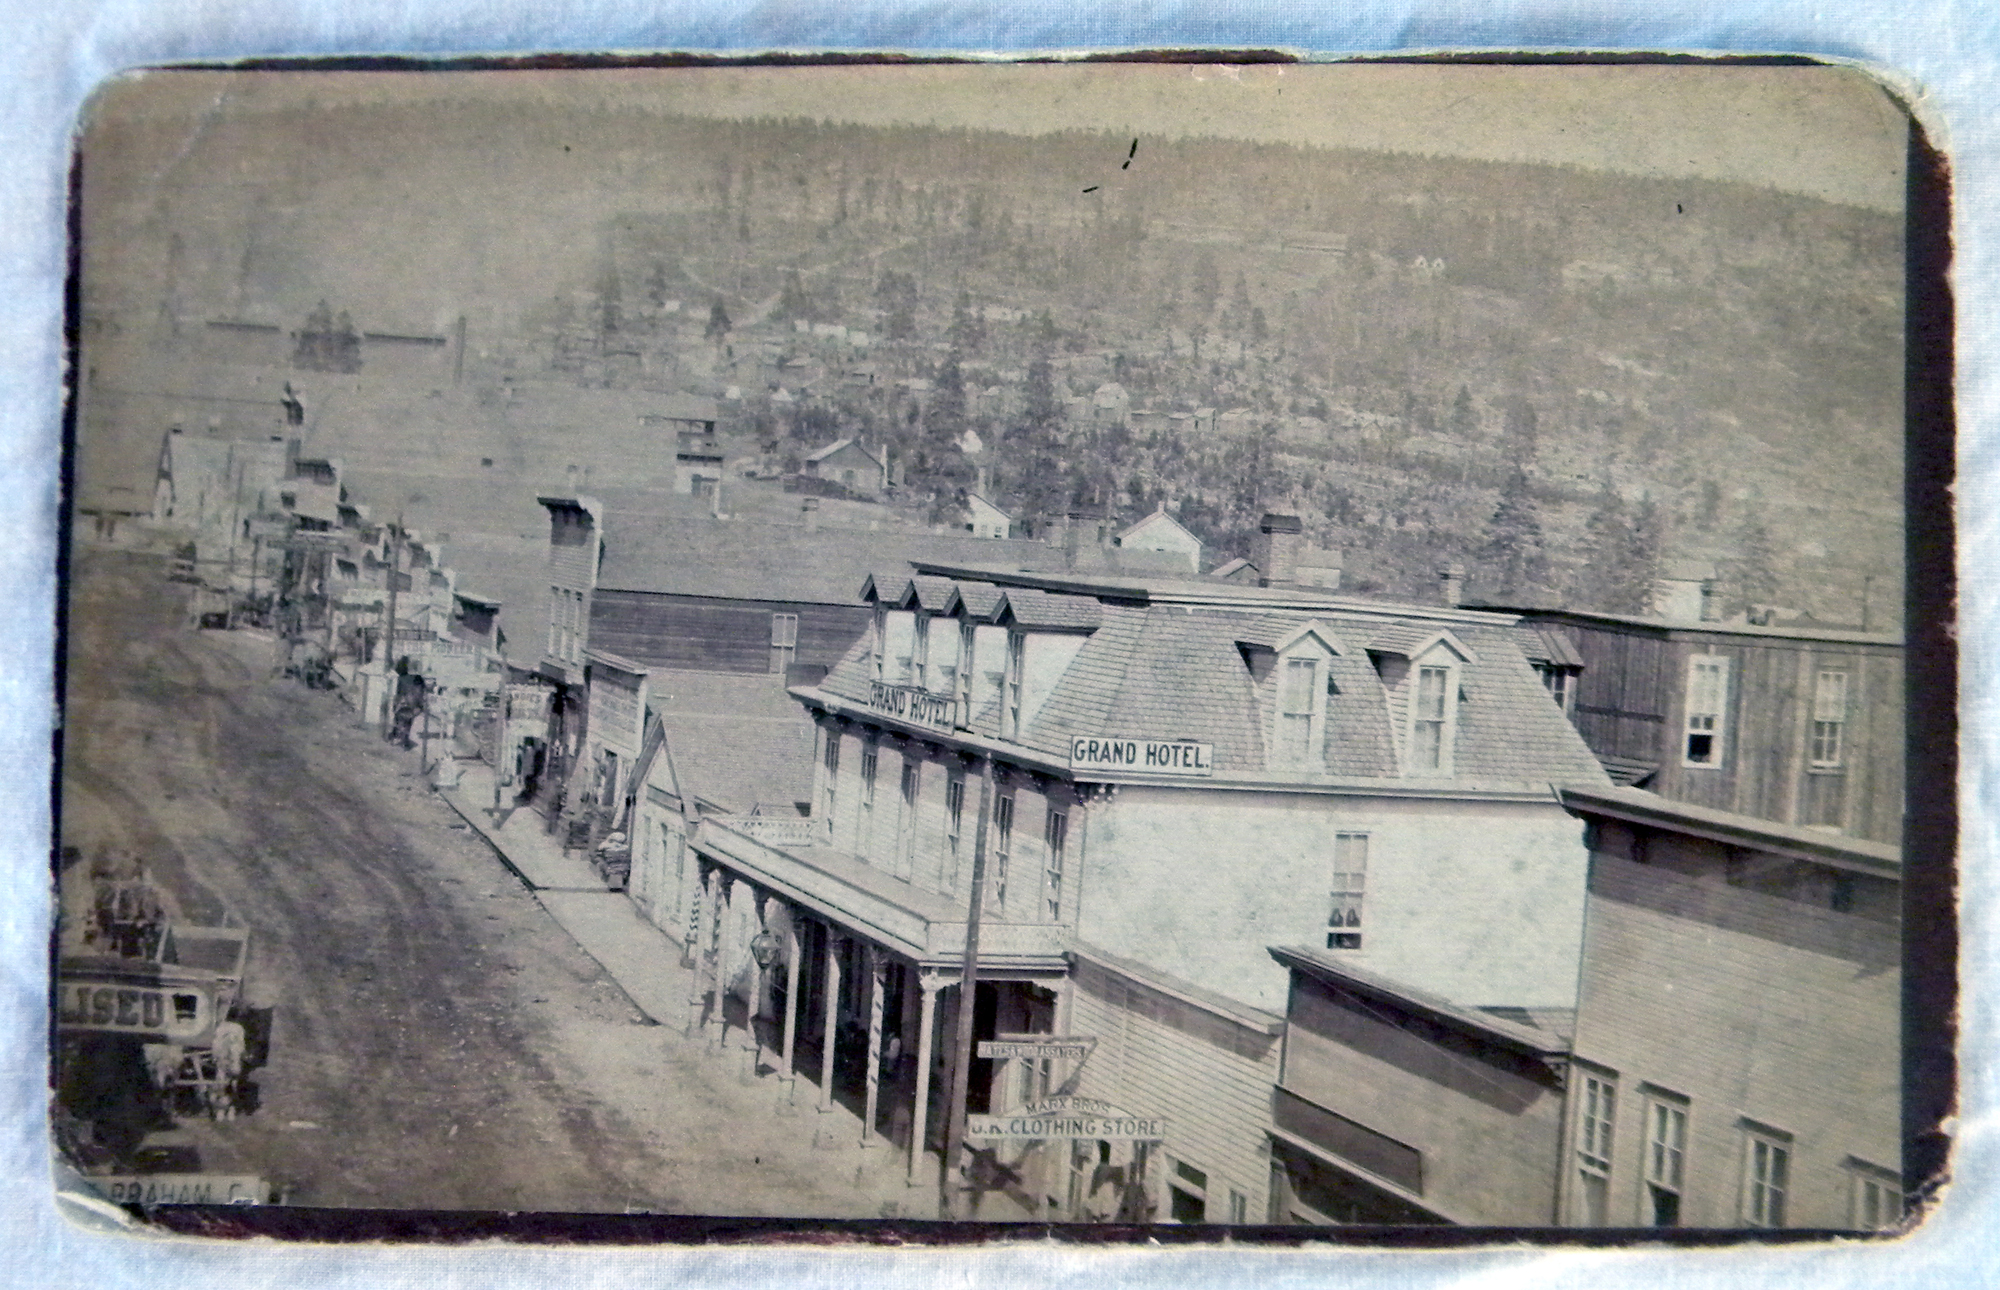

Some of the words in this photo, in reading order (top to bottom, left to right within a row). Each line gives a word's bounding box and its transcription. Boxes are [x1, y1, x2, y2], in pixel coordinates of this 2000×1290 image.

[870, 684, 906, 715] GRAND
[1073, 739, 1137, 765] GRAND
[1146, 743, 1211, 769] HOTEL.
[1025, 1099, 1068, 1115] MARX
[1010, 1118, 1096, 1136] CLOTHING
